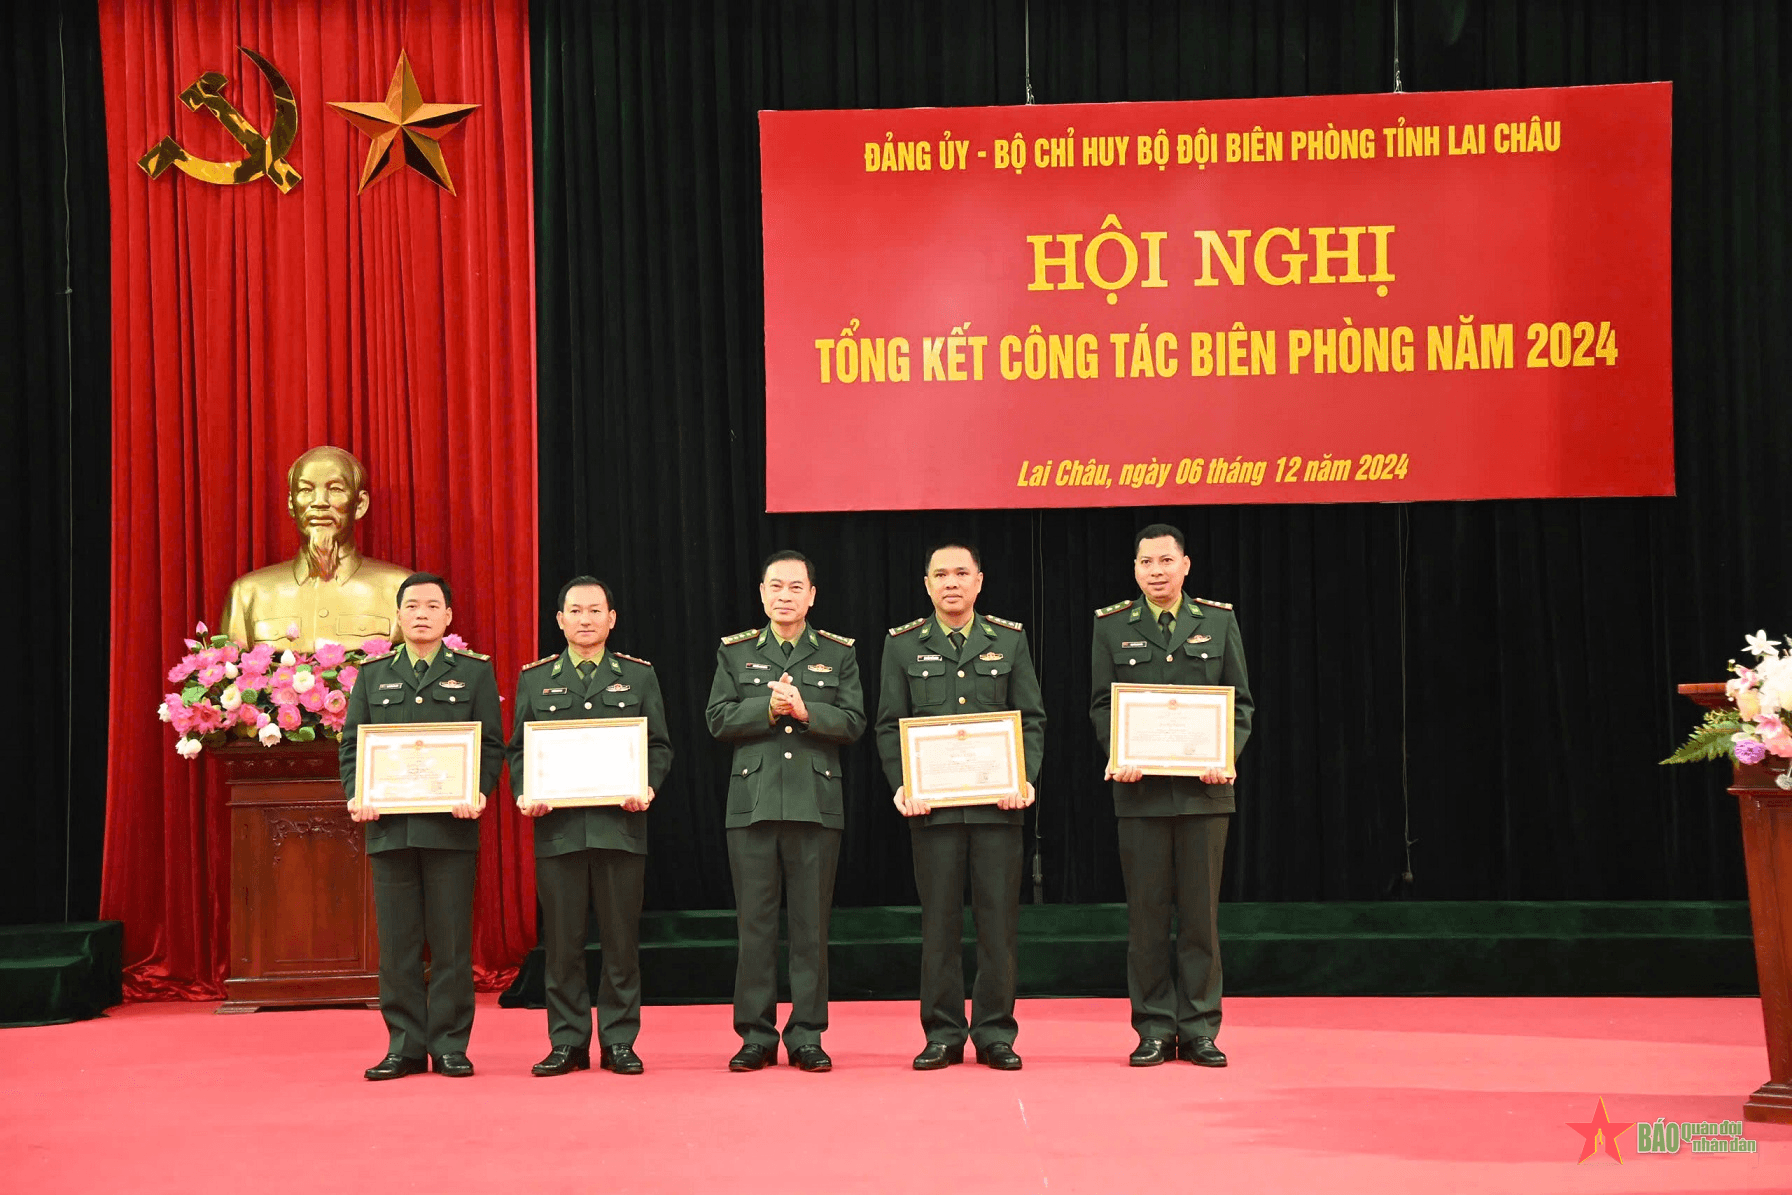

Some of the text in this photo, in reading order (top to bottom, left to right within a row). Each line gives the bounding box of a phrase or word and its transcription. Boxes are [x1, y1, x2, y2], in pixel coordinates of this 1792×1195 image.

[863, 131, 932, 172] ĐẢNG
[938, 130, 970, 171] ỦY
[994, 131, 1027, 175] BỘ
[1034, 126, 1075, 169] CHỈ
[1082, 135, 1130, 167] HUY
[1136, 128, 1170, 172] BỘ
[1176, 126, 1218, 171] ĐỘI
[1225, 125, 1283, 163] BIÊN
[1291, 122, 1375, 161] PHÒNG
[1382, 116, 1440, 158] TỈNH
[1448, 123, 1486, 156] LAI
[1493, 114, 1561, 154] CHÂU
[1026, 213, 1396, 306] HỘI NGHỊ
[814, 314, 1619, 384] TỔNG KẾT CÔNG TÁC BIÊN PHÒNG NĂM 2024
[1016, 453, 1410, 489] Lai Châu, ngày 06 tháng 12 năm 2024
